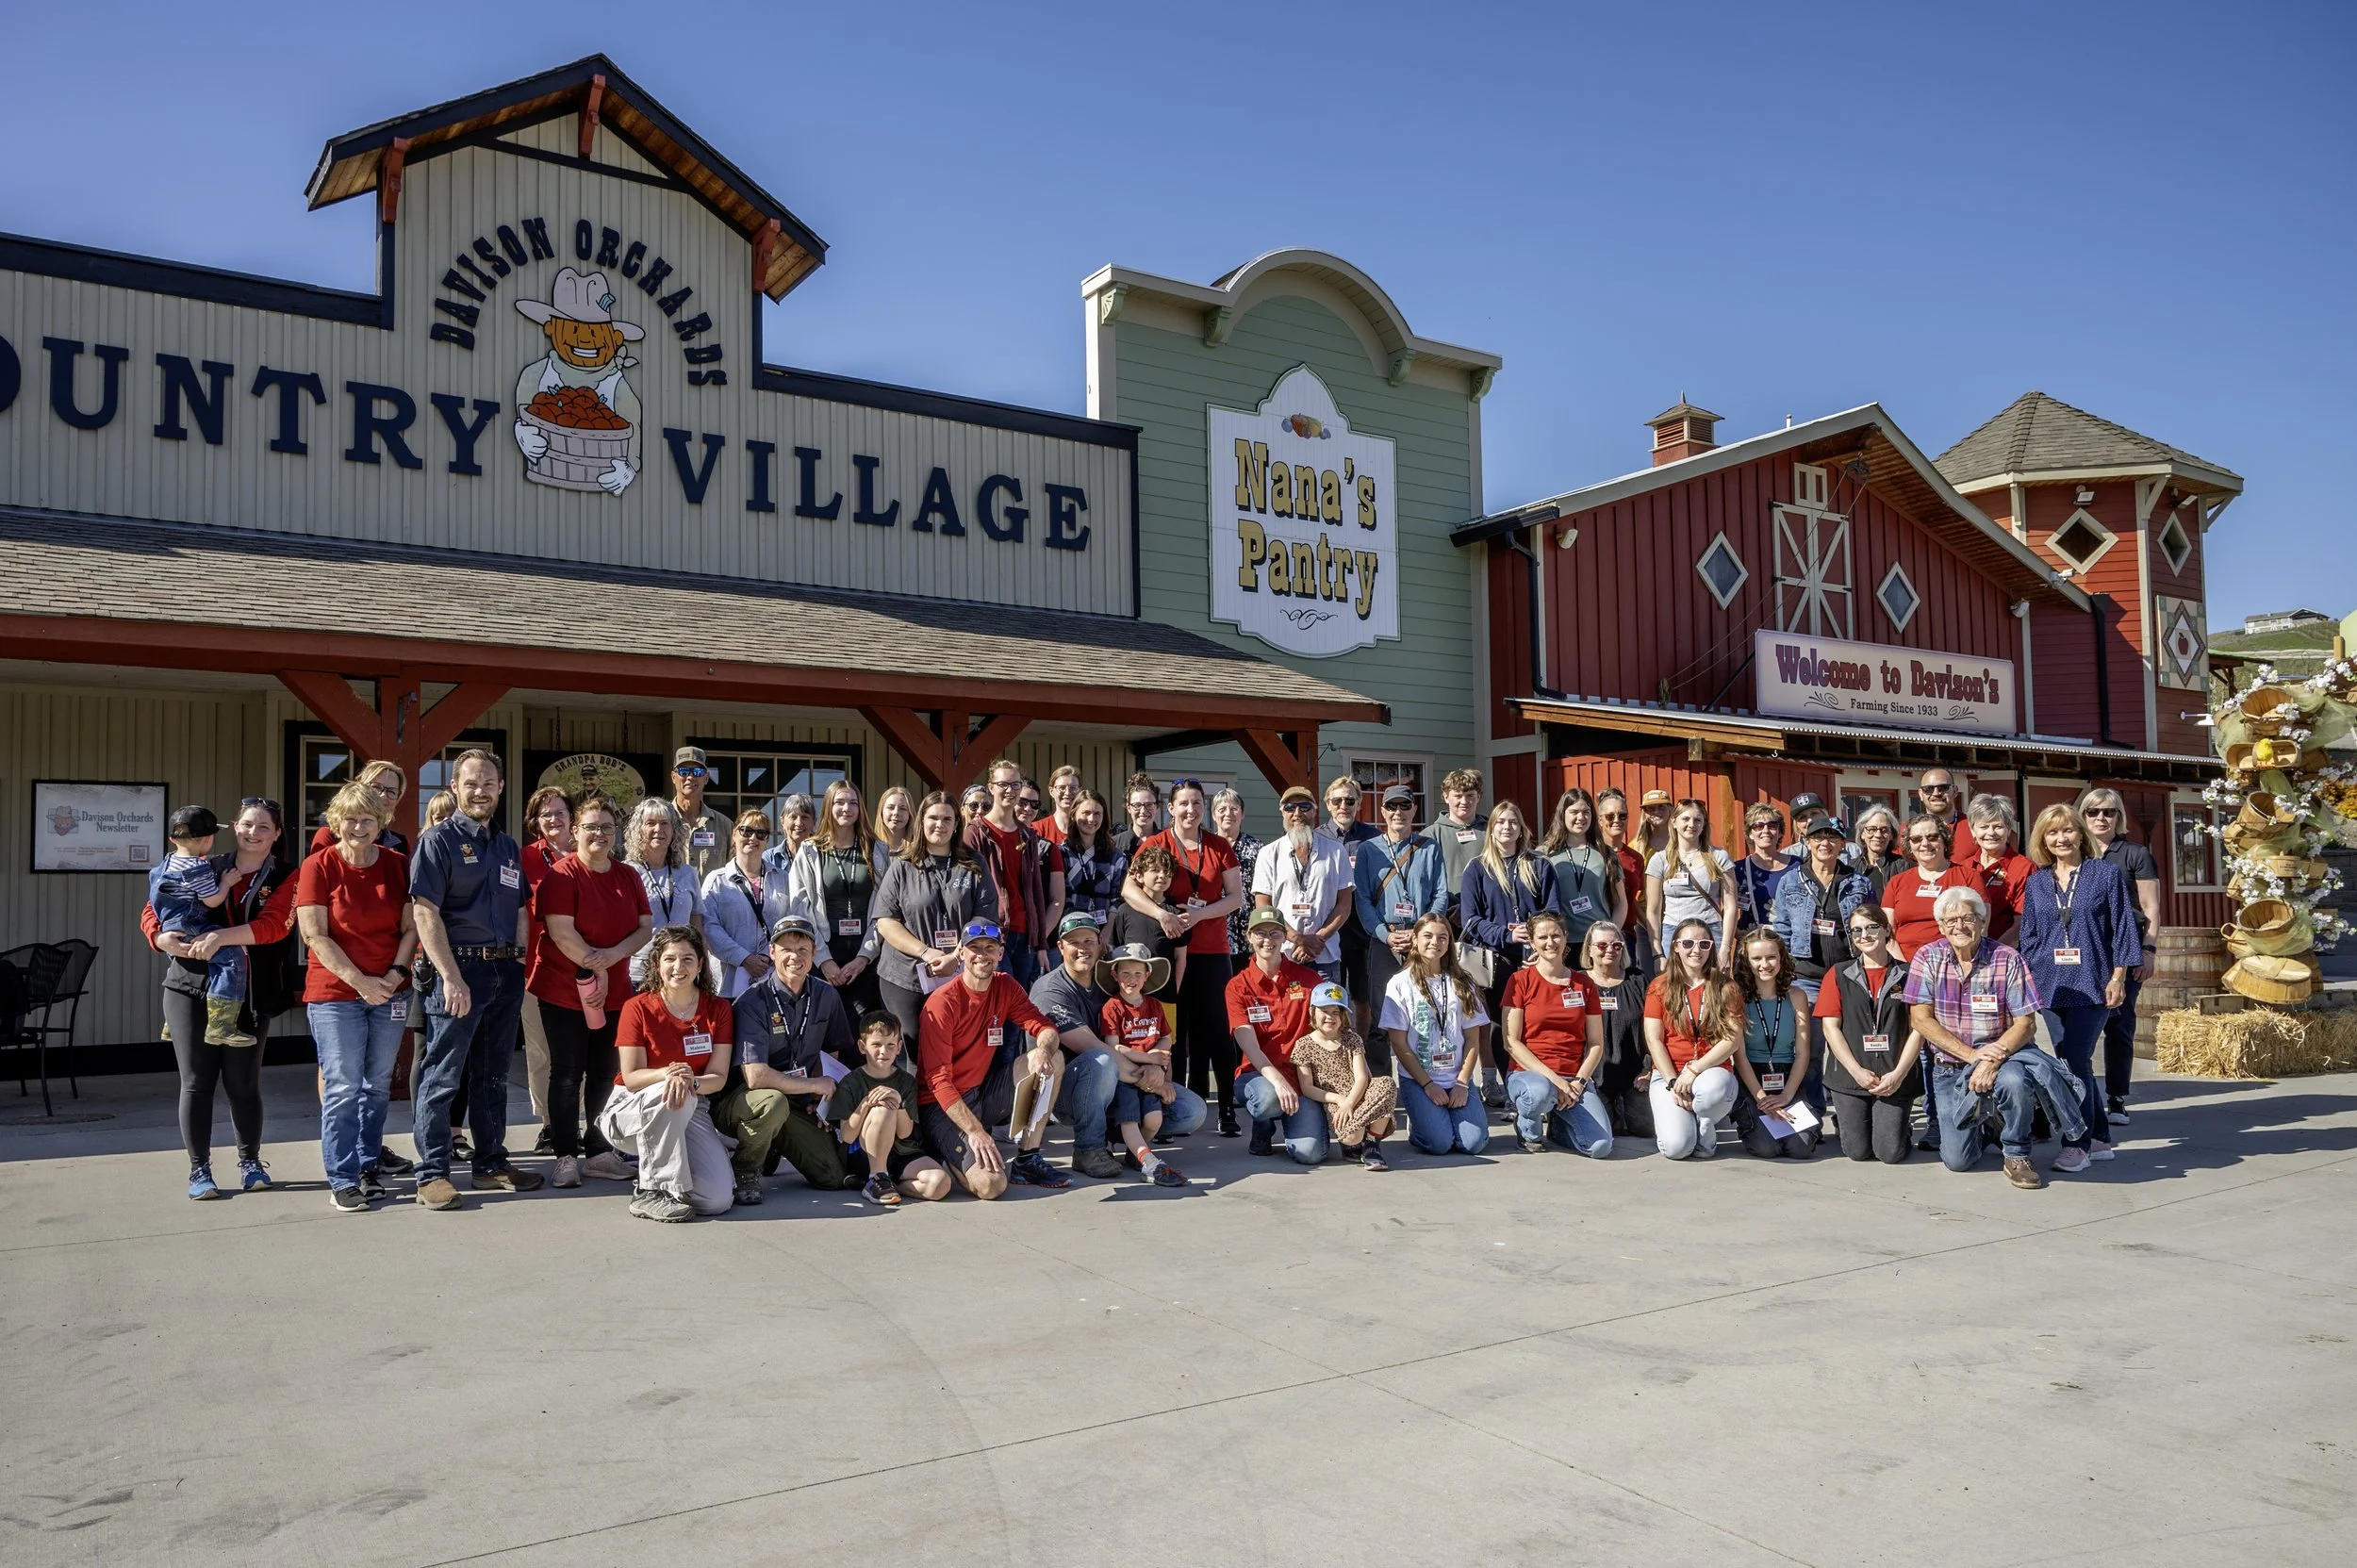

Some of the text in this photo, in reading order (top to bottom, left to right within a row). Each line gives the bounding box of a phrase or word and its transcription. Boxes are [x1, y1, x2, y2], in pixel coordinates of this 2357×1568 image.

[430, 217, 728, 386] DAVISON ORCHARDS
[0, 335, 1091, 552] UNTRY VILLAGE
[1235, 437, 1377, 531] Nana's
[1238, 519, 1378, 621] Pantry
[1775, 644, 2000, 704] Welcome to Davison's
[1850, 698, 1938, 717] Farming Since 1933
[554, 754, 627, 772] GRANDPA BOB'S
[82, 811, 154, 823] Davison Orchards
[96, 821, 140, 833] Newsletter
[1056, 1018, 1071, 1028] STAFF
